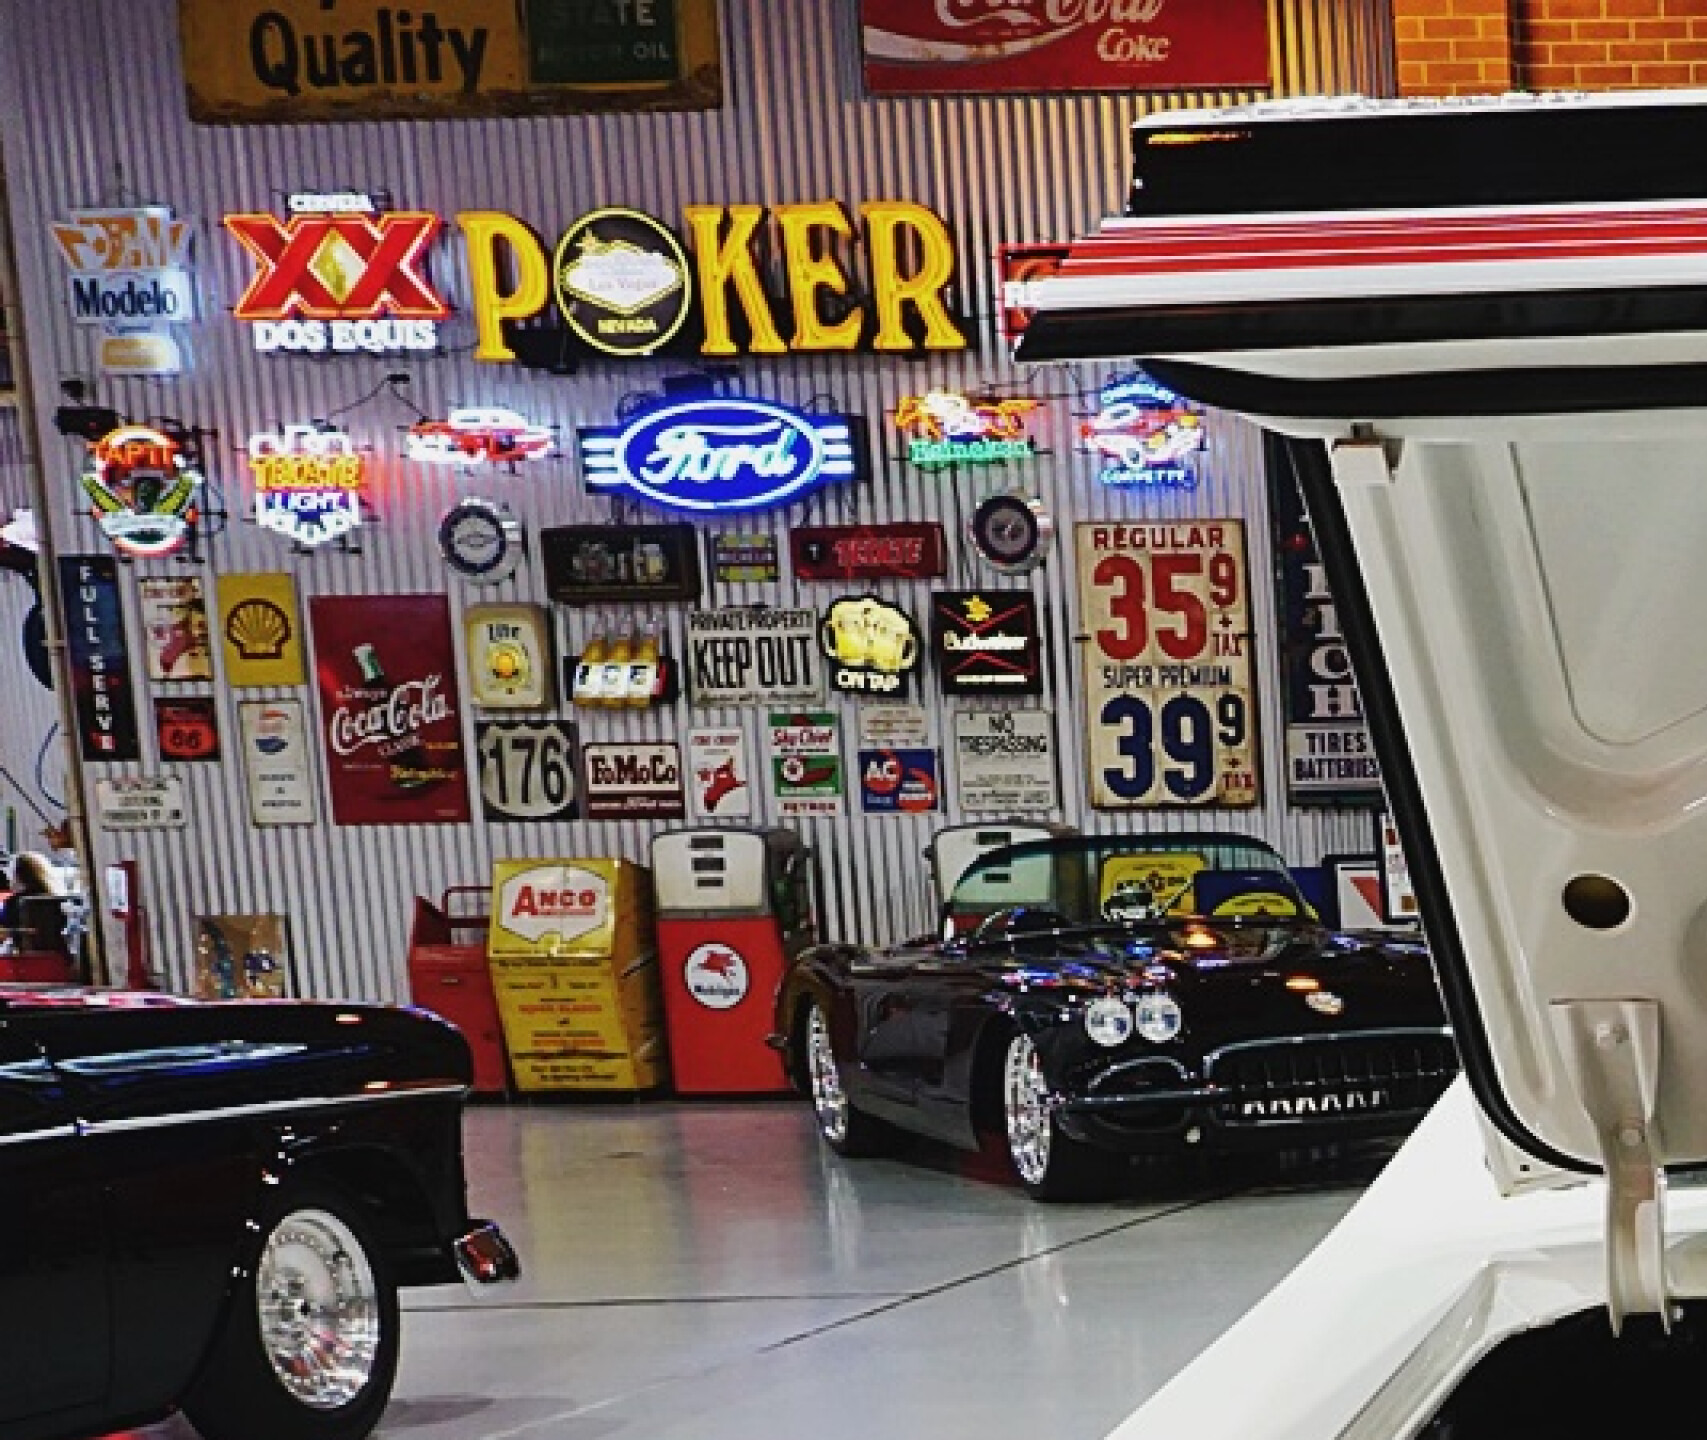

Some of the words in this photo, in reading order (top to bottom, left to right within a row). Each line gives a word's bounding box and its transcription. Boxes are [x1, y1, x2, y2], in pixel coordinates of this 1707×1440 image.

[249, 10, 487, 97] Quality
[632, 43, 669, 61] OIL
[1096, 27, 1171, 63] Coke
[224, 212, 450, 319] XX
[73, 277, 177, 318] Modelo
[253, 319, 326, 353] DOS
[331, 319, 440, 353] EQUIS
[640, 421, 798, 485] Ford
[1092, 526, 1224, 550] REGULAR
[79, 564, 100, 644] FULL
[1092, 553, 1207, 661] 35
[1208, 552, 1237, 609] 9
[693, 635, 752, 689] KEEP
[755, 635, 813, 688] OUT
[1211, 633, 1243, 657] TAX
[1102, 665, 1157, 690] SUPER
[1160, 665, 1233, 690] PREMIUM
[329, 673, 455, 755] Coca-Cola
[771, 729, 797, 747] Sky
[799, 729, 834, 746] Chief
[1099, 693, 1215, 801] 39
[1217, 693, 1246, 747] 9
[1305, 732, 1368, 755] TIRES
[487, 735, 568, 807] 176
[590, 754, 678, 784] FoMoCo
